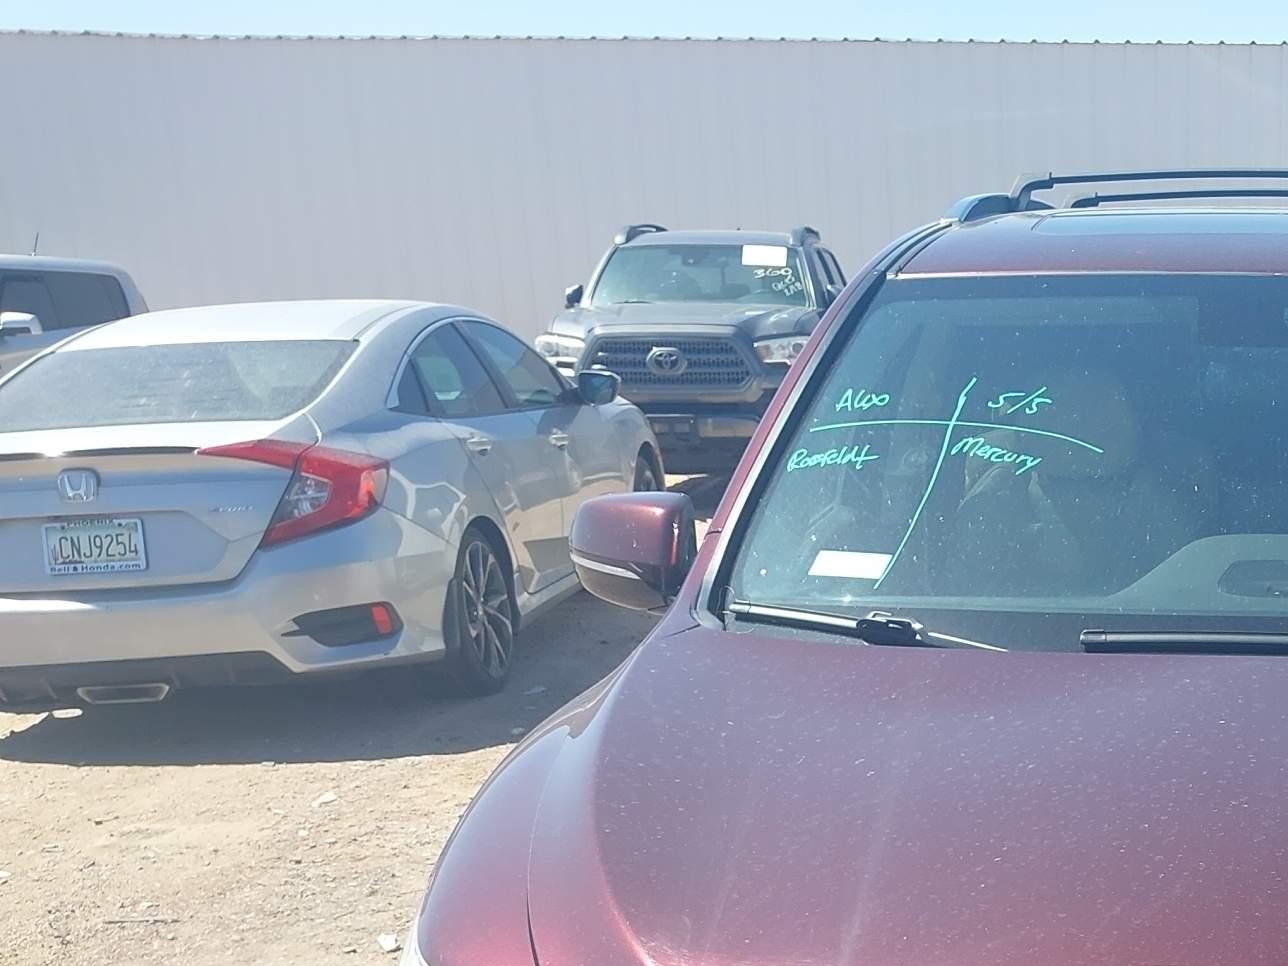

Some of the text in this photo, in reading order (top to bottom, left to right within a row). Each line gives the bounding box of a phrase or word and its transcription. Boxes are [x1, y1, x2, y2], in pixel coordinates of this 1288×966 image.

[987, 386, 1053, 415] 5/5
[951, 437, 1042, 475] Mercury
[58, 533, 139, 560] CNJ9254
